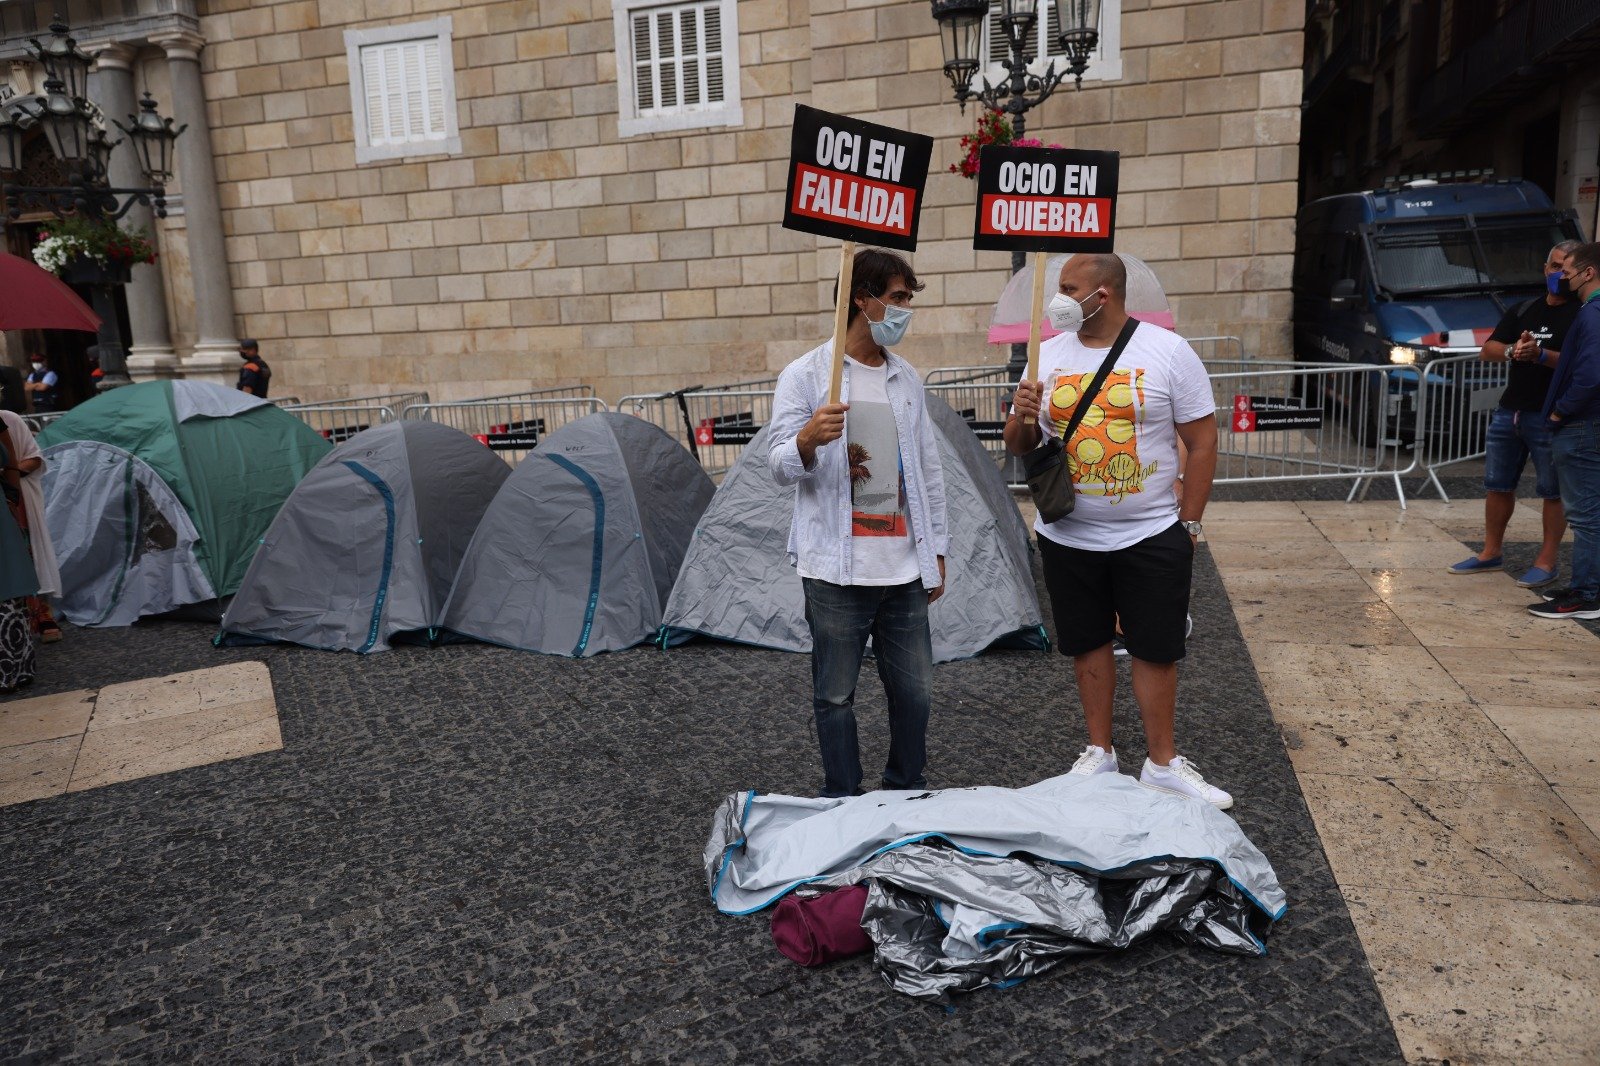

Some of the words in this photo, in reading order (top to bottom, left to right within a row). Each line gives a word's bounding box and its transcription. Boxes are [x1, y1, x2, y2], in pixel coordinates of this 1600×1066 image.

[816, 126, 862, 173] OCI
[866, 138, 906, 183] EN
[998, 161, 1057, 195] OCIO
[1063, 164, 1098, 196] EN
[798, 170, 905, 230] FALLIDA
[991, 199, 1100, 235] QUIEBRA
[1405, 200, 1434, 208] T-132
[1257, 418, 1287, 426] Ajuntament
